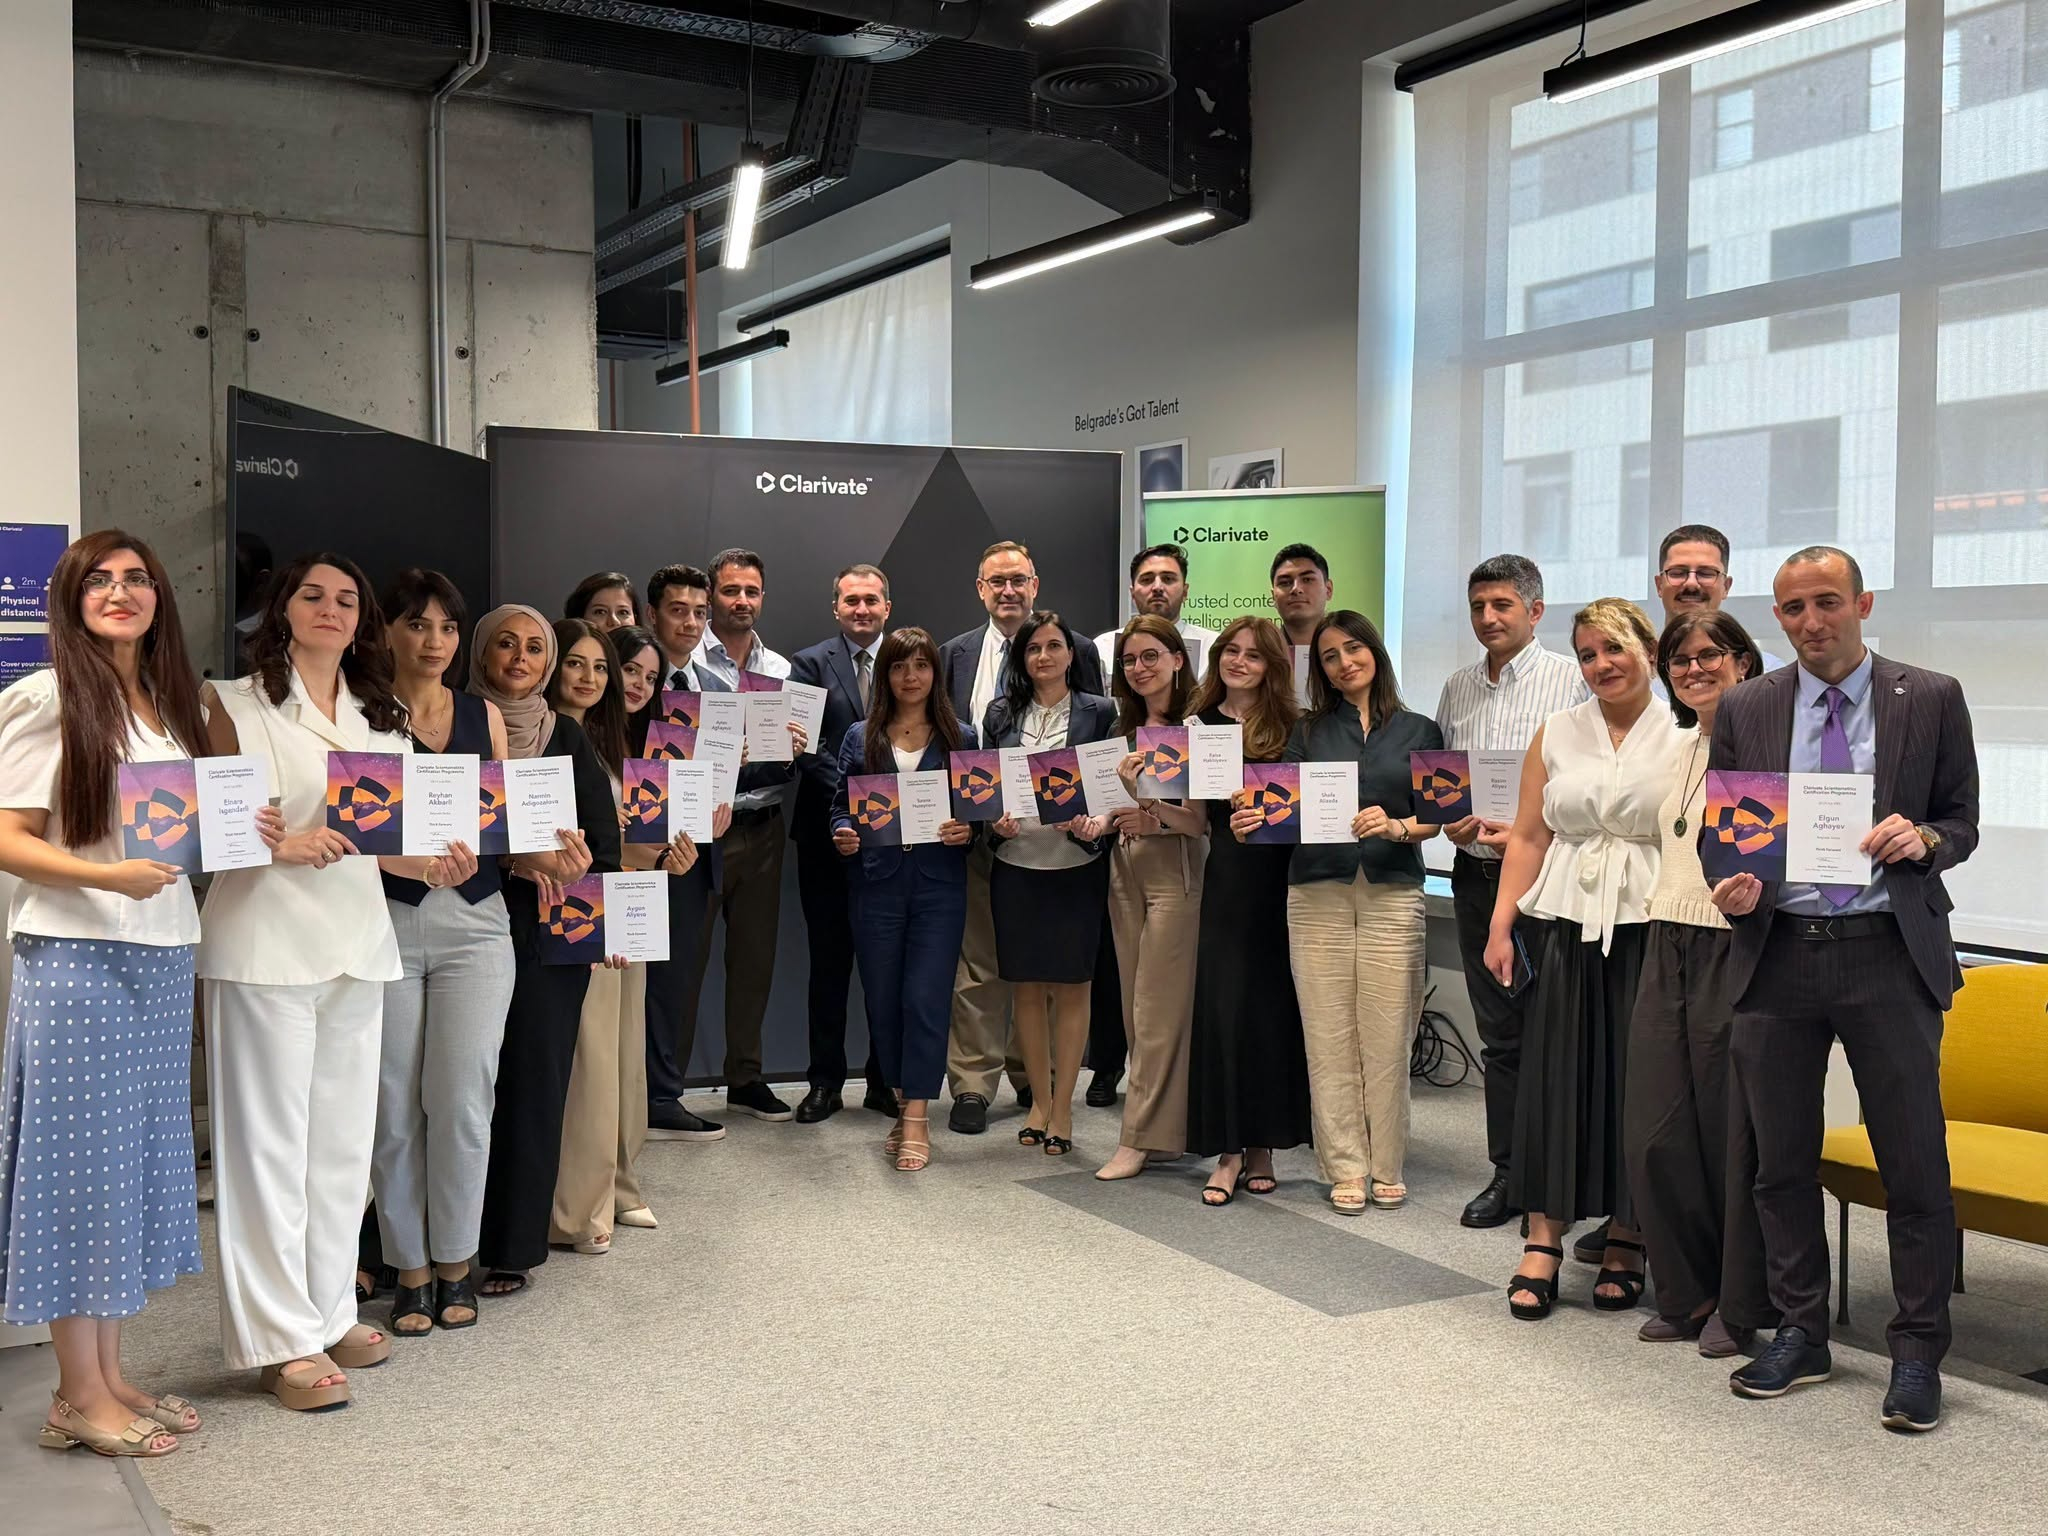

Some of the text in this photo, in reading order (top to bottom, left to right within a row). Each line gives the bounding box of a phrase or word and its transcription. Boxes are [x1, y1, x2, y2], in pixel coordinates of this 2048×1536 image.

[1075, 397, 1179, 433] Belgrade's Got Talent
[1193, 526, 1269, 542] Clarivate
[21, 576, 37, 586] 2m
[1, 596, 39, 606] Physical
[429, 792, 452, 800] Reyhan
